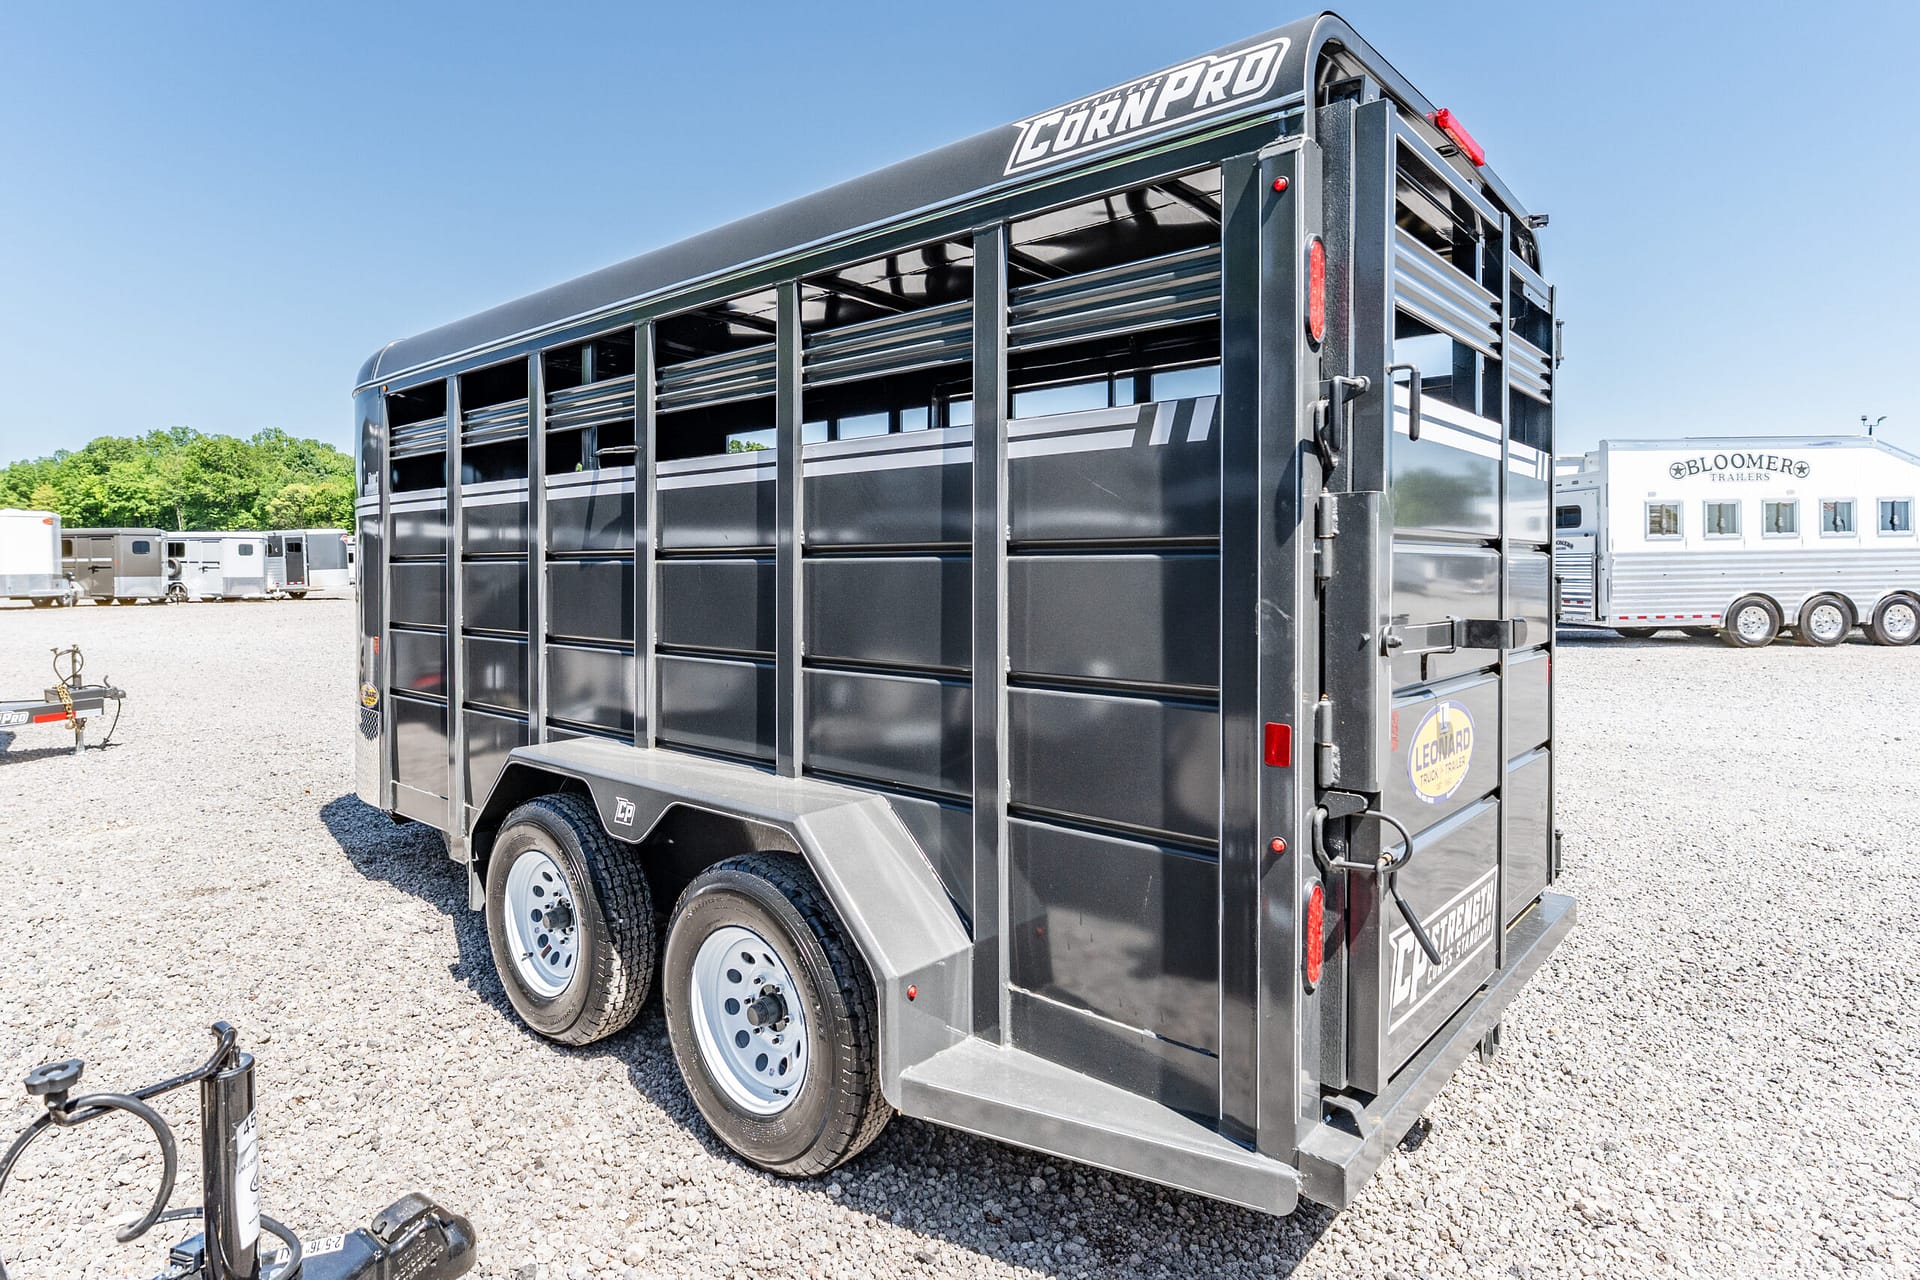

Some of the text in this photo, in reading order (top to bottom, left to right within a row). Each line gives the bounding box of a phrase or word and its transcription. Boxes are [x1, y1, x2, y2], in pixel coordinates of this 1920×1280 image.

[1685, 453, 1793, 476] BLOOMER
[1711, 472, 1771, 482] TRAILERS
[1415, 727, 1470, 772] LEONARD
[1420, 769, 1438, 787] TRUCK
[618, 801, 634, 822] CP
[1431, 879, 1494, 956] STRENGTH
[1456, 914, 1491, 960] STANDARD
